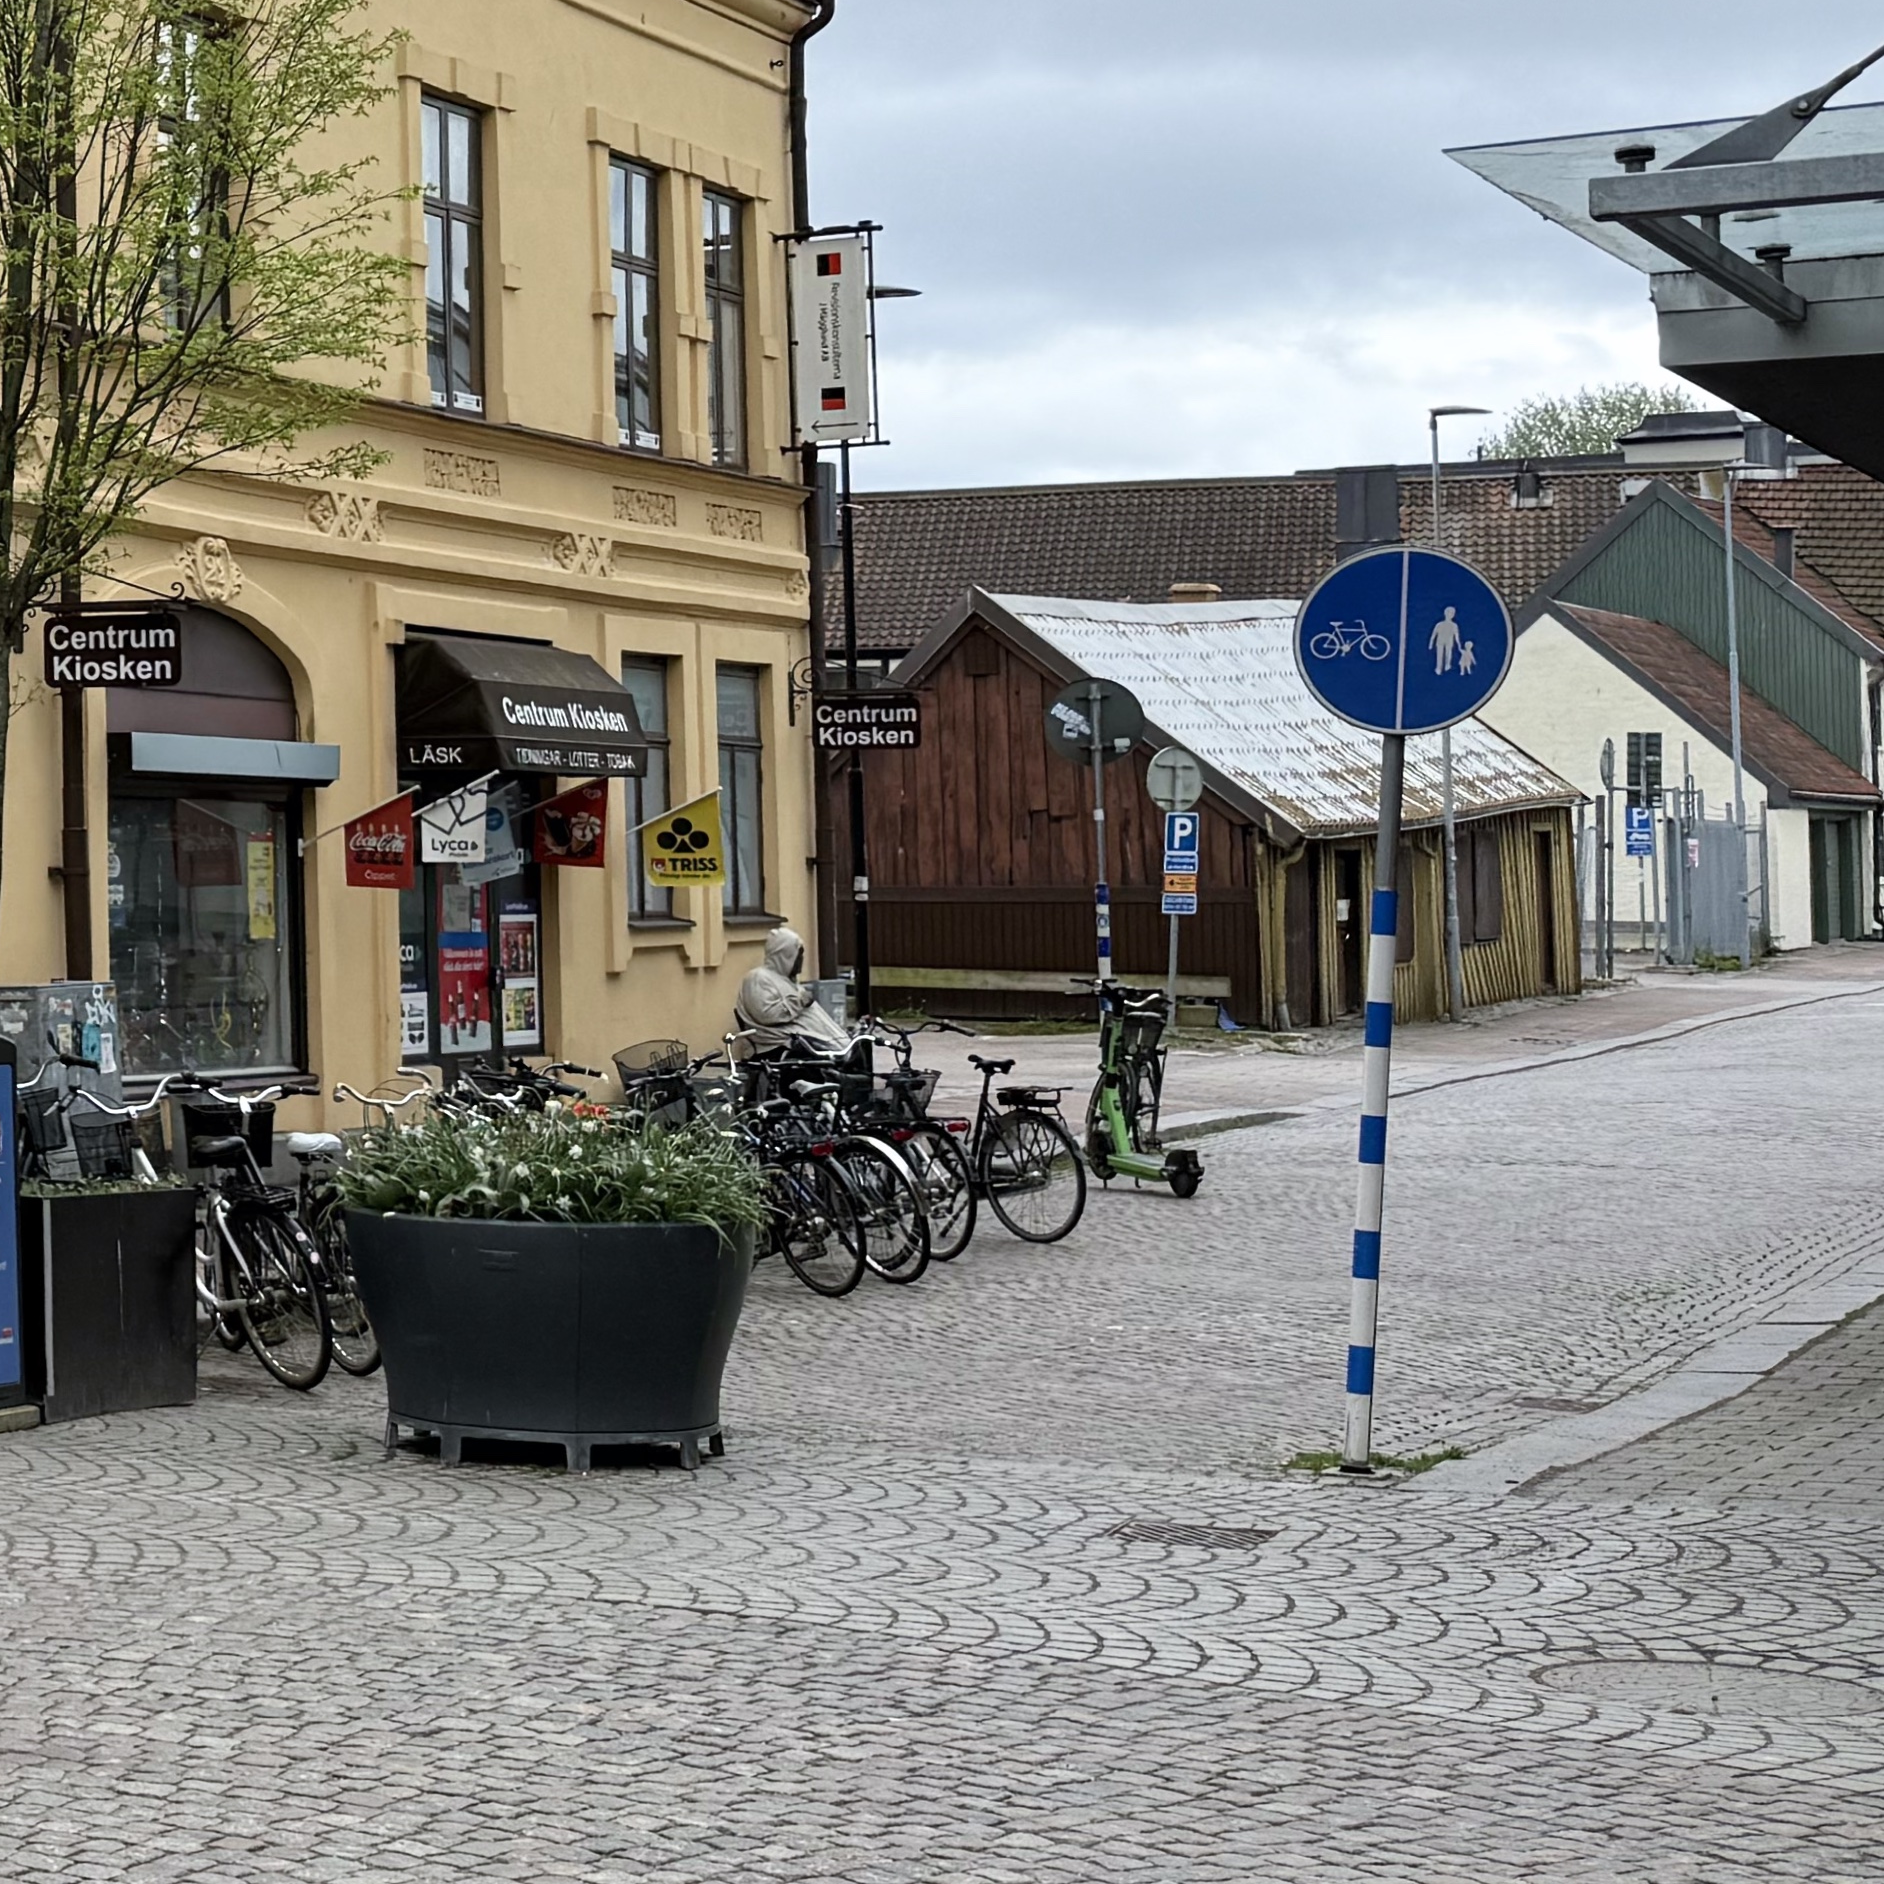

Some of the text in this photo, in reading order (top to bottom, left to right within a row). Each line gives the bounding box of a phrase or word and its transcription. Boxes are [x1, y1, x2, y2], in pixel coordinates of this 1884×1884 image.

[49, 624, 175, 650] Centrum
[52, 654, 172, 681] Kiosken
[502, 696, 629, 732] Centrum Kiosken
[816, 704, 917, 724] Centrum
[819, 726, 914, 746] Kiosken
[409, 745, 463, 764] LÄSK
[516, 747, 562, 766] TIDNINGAR
[568, 751, 600, 768] LOTTER
[606, 753, 636, 769] TOBAK
[1173, 817, 1192, 849] P
[431, 837, 469, 854] Lyca
[668, 857, 718, 872] TRISS
